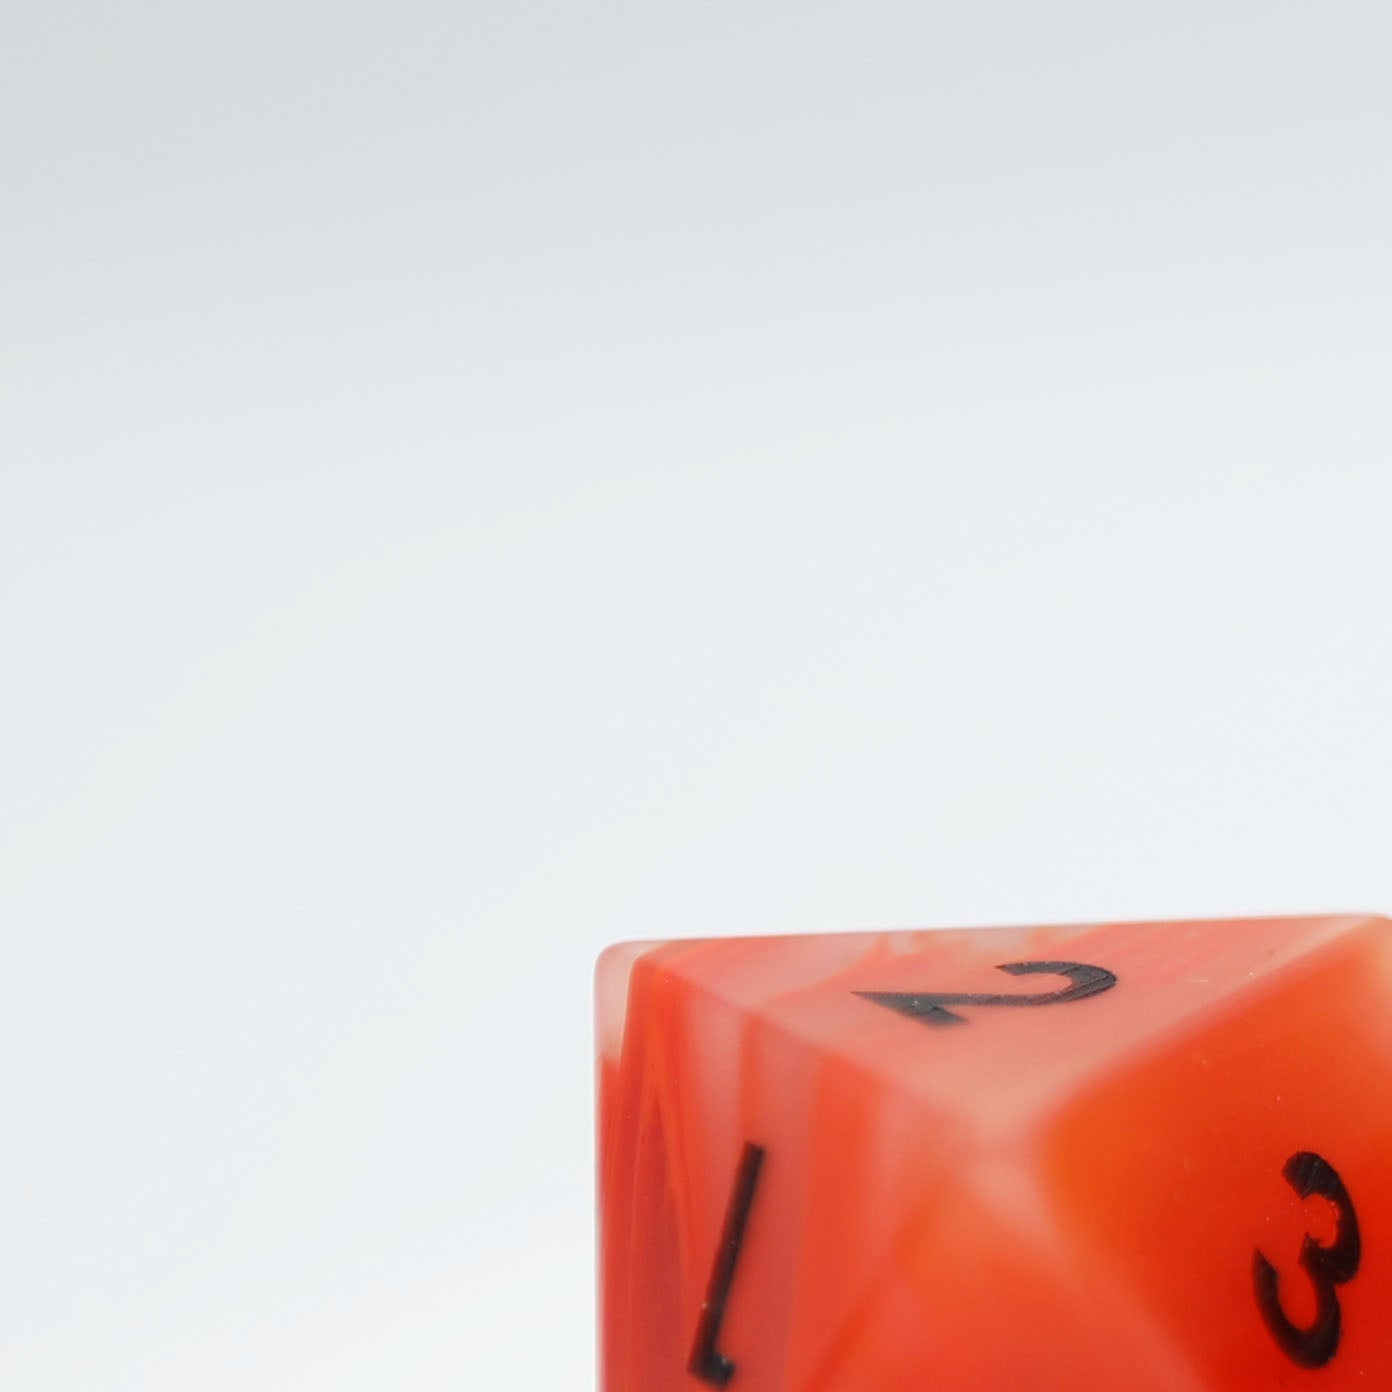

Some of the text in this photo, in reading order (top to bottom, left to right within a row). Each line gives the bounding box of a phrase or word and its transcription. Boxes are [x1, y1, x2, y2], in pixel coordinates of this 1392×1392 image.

[850, 961, 1118, 1028] 2
[688, 1142, 766, 1392] 1
[1255, 1151, 1362, 1369] 3
